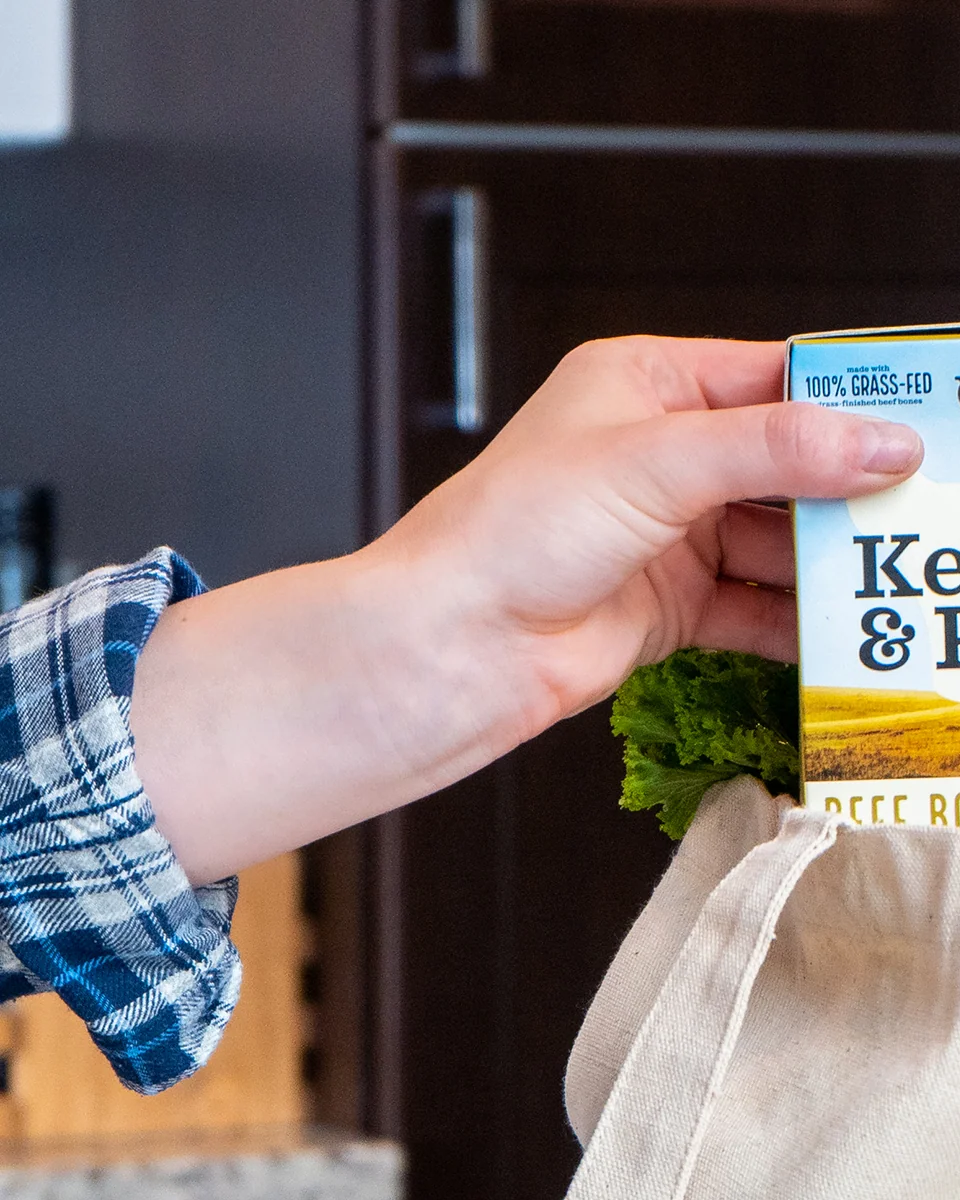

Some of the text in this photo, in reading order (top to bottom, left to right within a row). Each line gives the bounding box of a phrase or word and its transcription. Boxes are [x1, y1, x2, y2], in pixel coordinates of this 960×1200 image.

[846, 364, 890, 373] made with
[805, 371, 932, 398] 100% GRASS-FED
[819, 398, 923, 407] rass-finished beef bones
[858, 607, 916, 672] &
